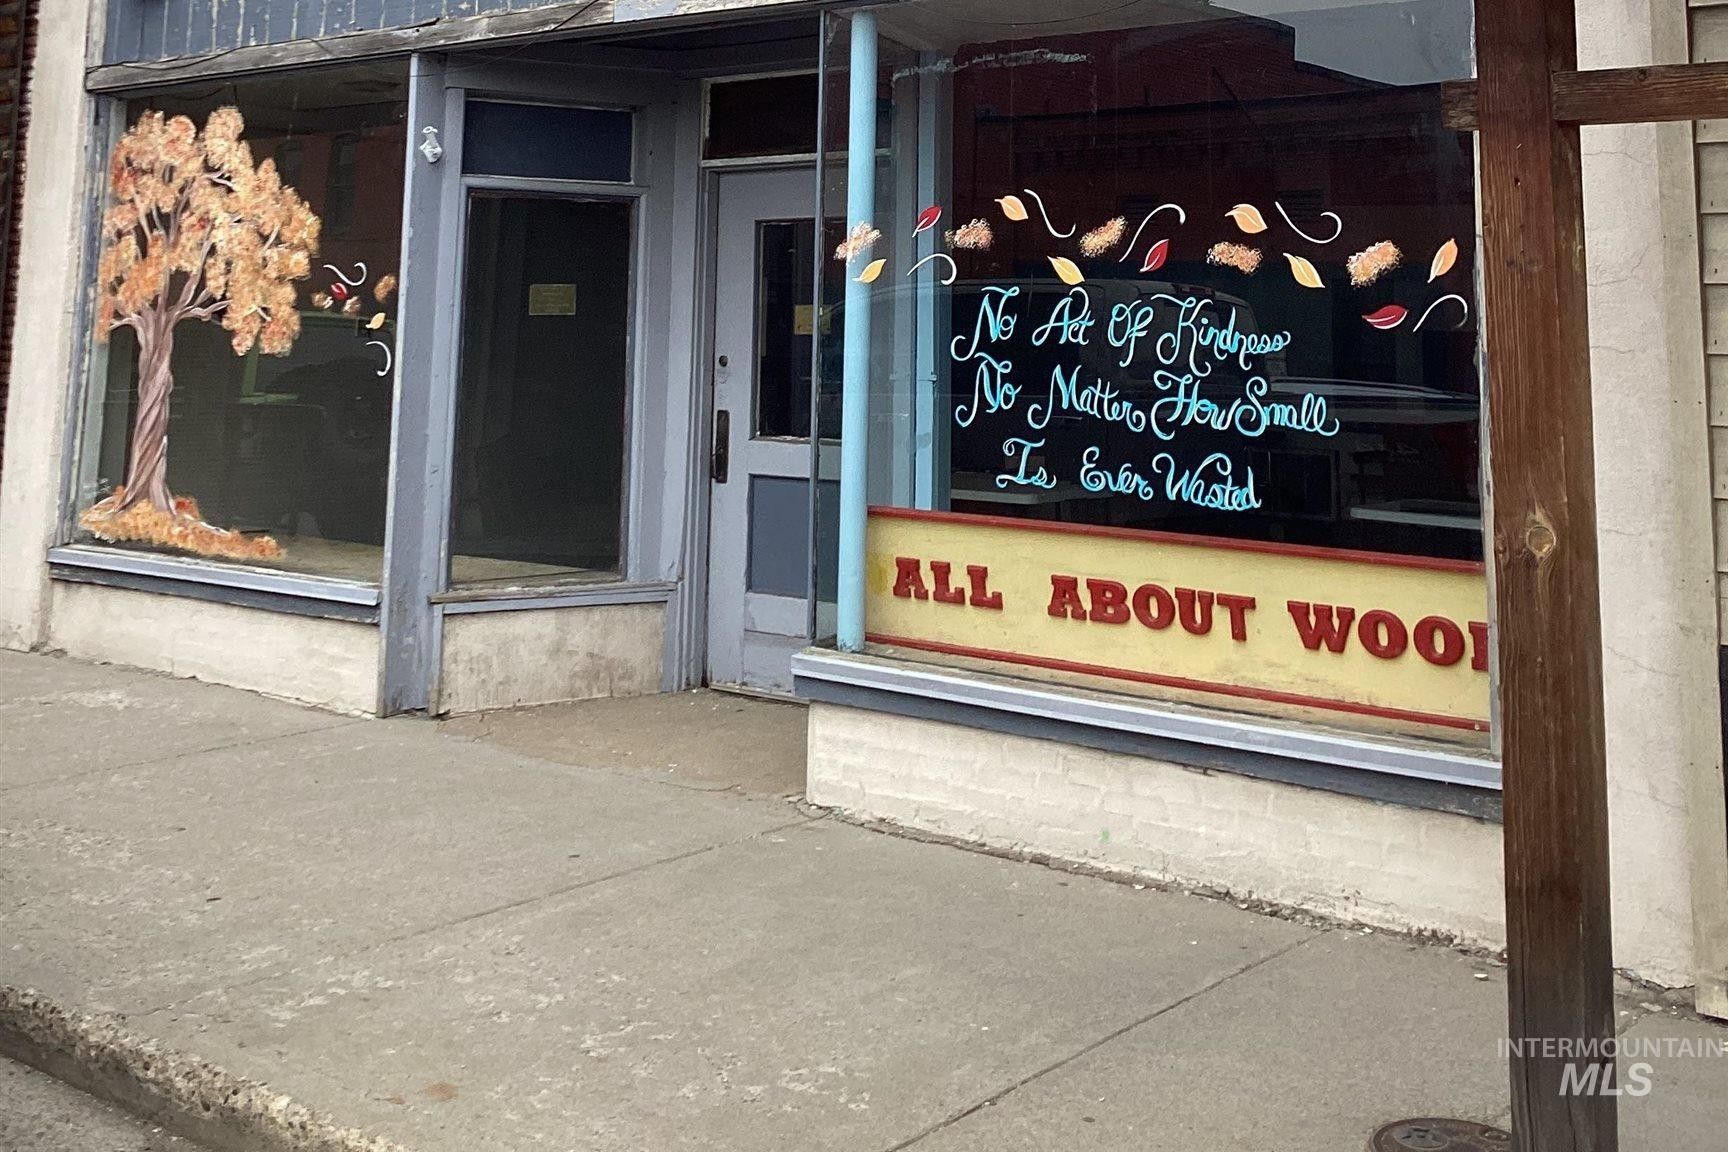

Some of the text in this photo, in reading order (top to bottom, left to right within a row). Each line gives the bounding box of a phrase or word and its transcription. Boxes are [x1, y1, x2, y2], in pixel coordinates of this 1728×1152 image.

[951, 286, 1292, 376] No Act Of Kindness
[955, 352, 1340, 440] No Matter How Small
[996, 438, 1262, 512] Is Ever Wasted
[892, 556, 1003, 610] ALL
[1047, 574, 1256, 642] ABOUT
